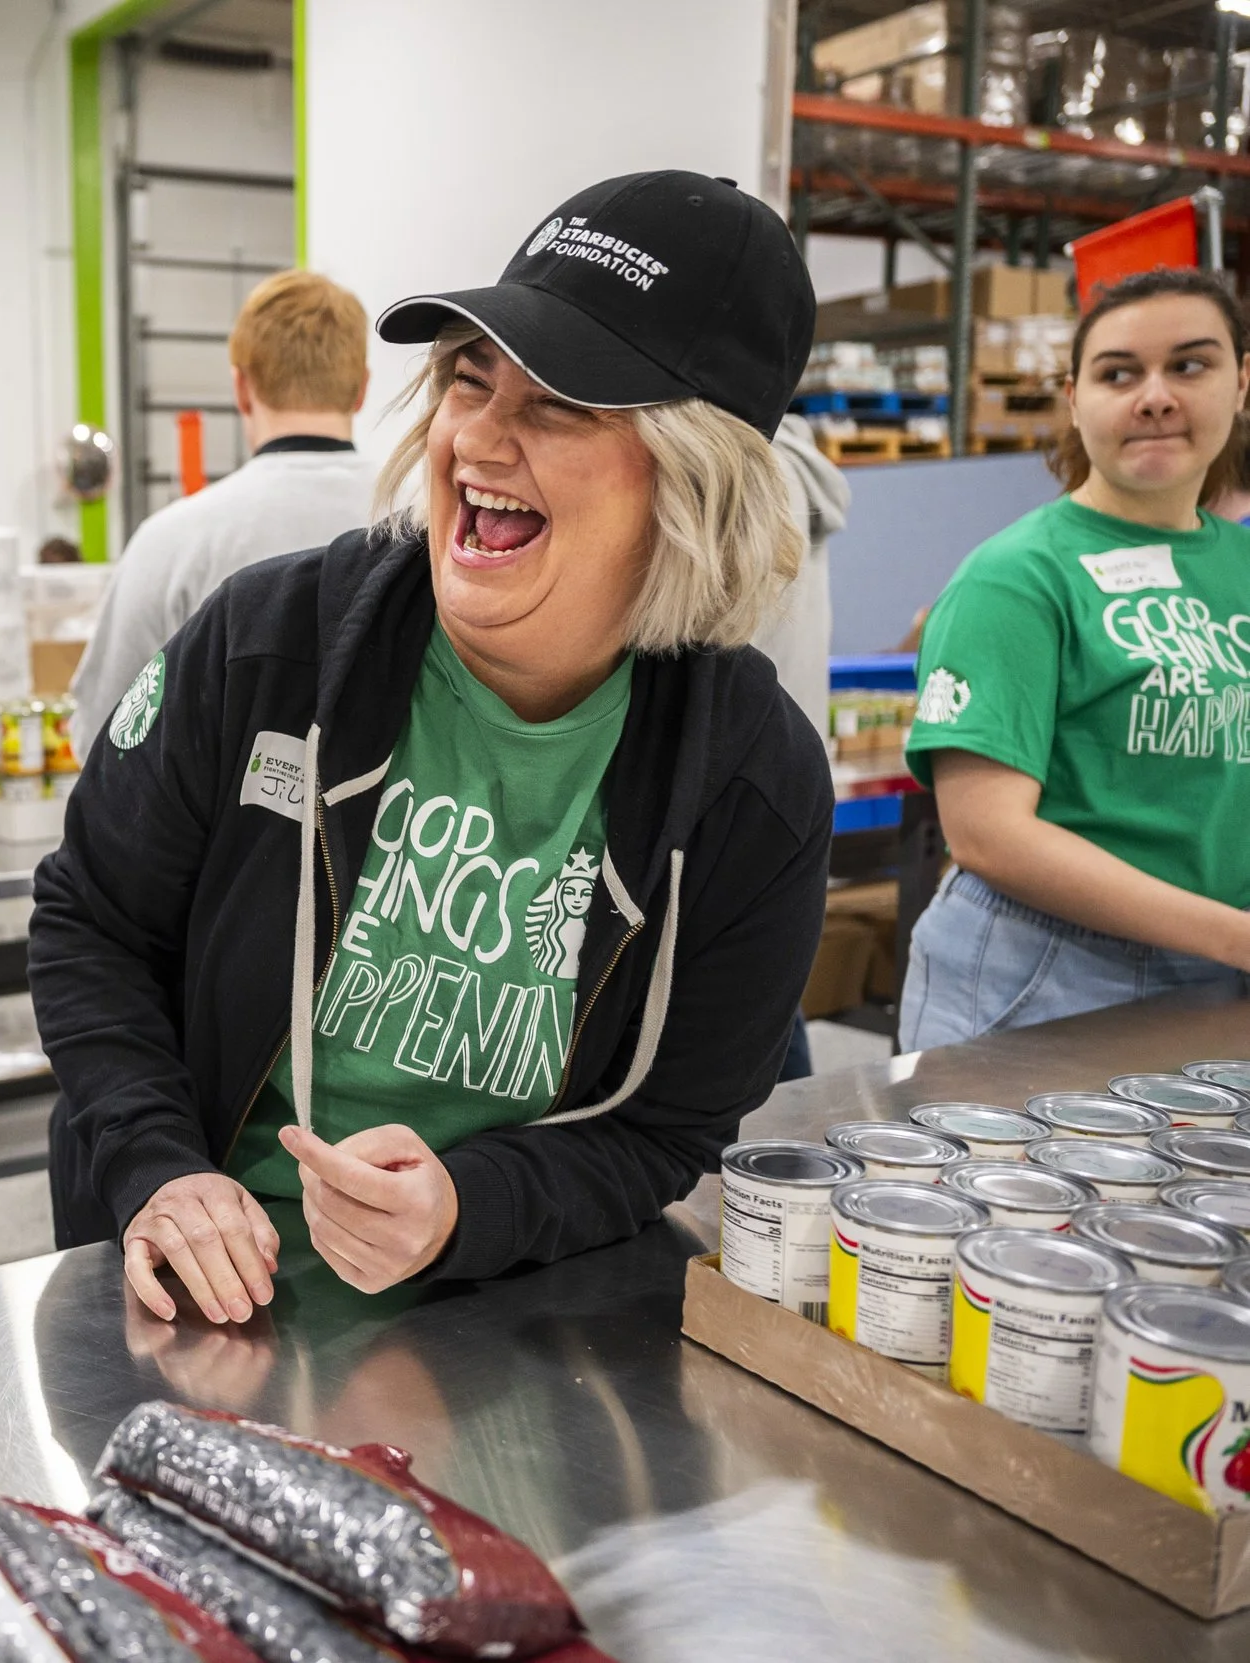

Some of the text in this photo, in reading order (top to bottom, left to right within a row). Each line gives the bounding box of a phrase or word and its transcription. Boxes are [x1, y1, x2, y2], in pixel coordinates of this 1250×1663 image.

[569, 216, 588, 227] THE
[547, 241, 654, 291] FOUNDATION
[1102, 595, 1211, 652] GOOD
[1140, 665, 1215, 697] ARE
[1127, 683, 1250, 764] HAPPE
[266, 757, 301, 774] EVERY
[372, 778, 495, 858] OOD
[357, 851, 540, 964] HINGS
[312, 952, 578, 1100] PPENIN
[753, 1194, 782, 1209] Facts
